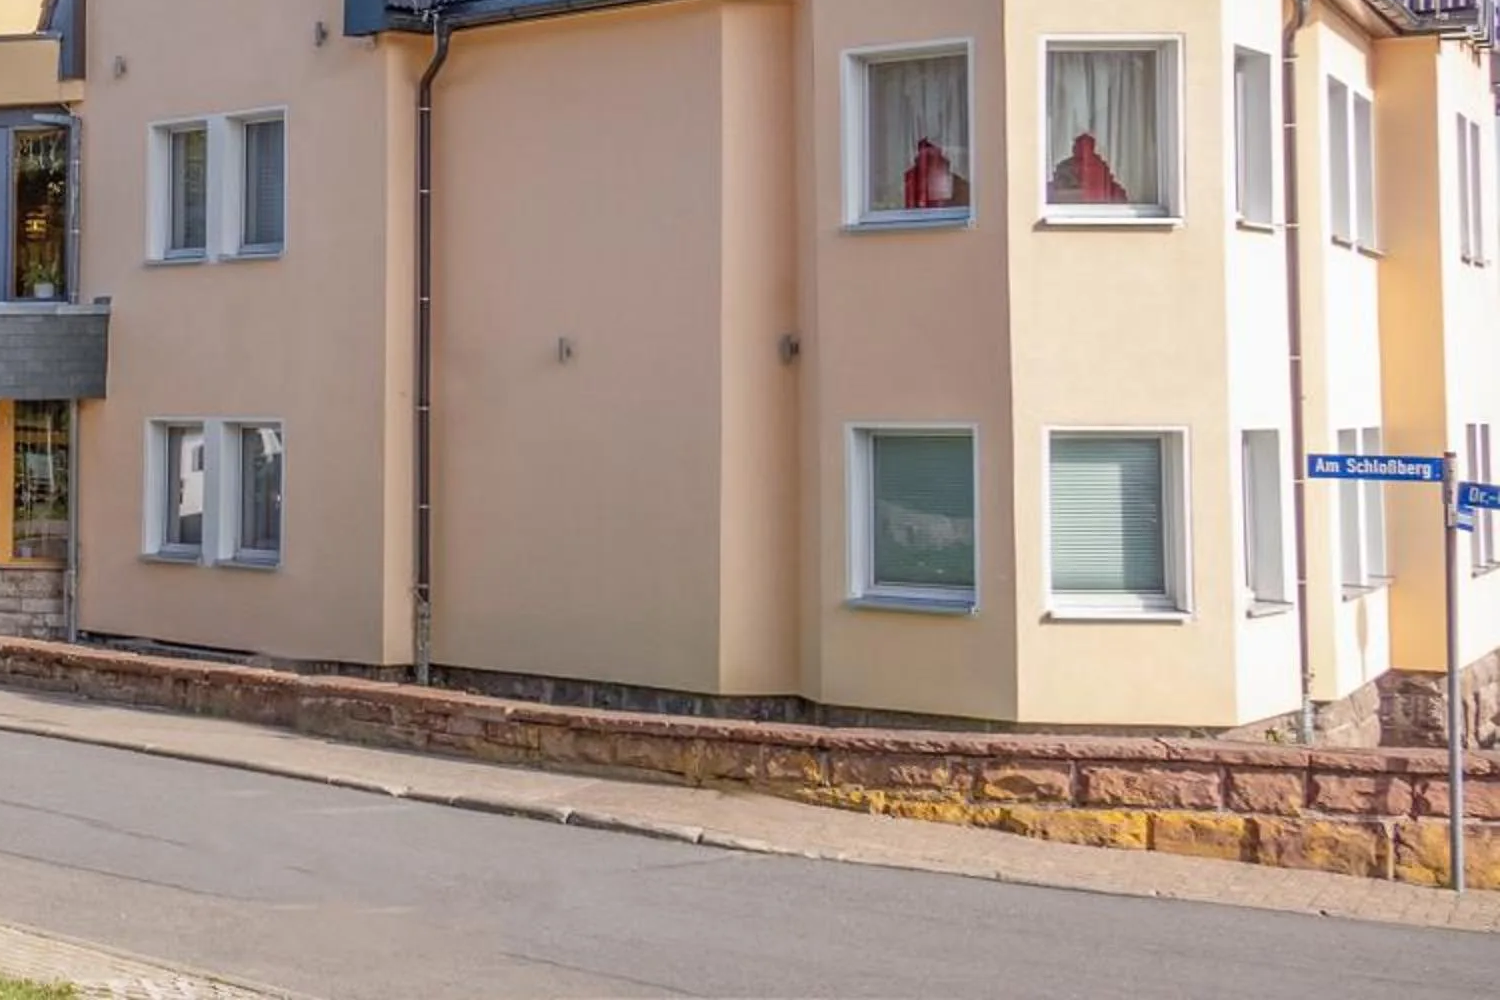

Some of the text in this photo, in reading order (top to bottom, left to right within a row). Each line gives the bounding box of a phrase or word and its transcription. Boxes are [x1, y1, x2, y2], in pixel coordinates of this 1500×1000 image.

[1315, 457, 1431, 479] Am Schloßberg
[1468, 486, 1500, 506] Dr.-
